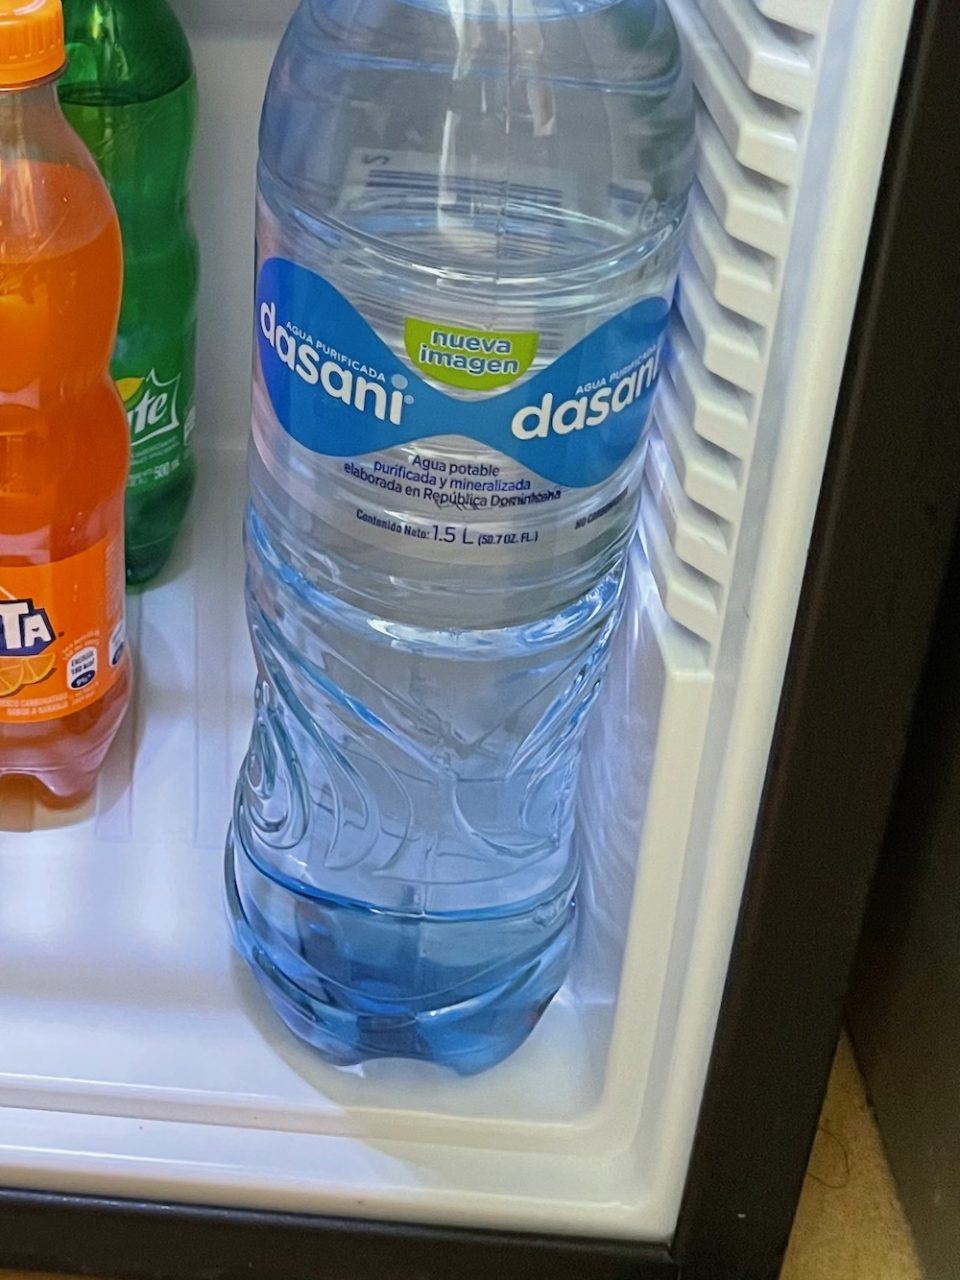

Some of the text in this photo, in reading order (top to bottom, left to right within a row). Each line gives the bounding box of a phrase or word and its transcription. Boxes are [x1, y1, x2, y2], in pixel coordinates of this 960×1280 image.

[286, 321, 386, 383] AGUA PURIFICADA
[419, 342, 520, 377] imagen
[431, 329, 513, 355] nueva
[260, 302, 409, 426] dasani
[575, 377, 607, 396] AGUA
[373, 460, 532, 492] purificada y mineralizada
[412, 455, 500, 477] Agua potable
[344, 461, 562, 508] elaborada en República Dominicana
[355, 508, 402, 533] Contenido
[403, 524, 430, 540] Neto:
[432, 524, 456, 544] 1.5
[462, 527, 474, 545] L
[477, 534, 501, 547] (50.7
[503, 534, 518, 545] OZ.
